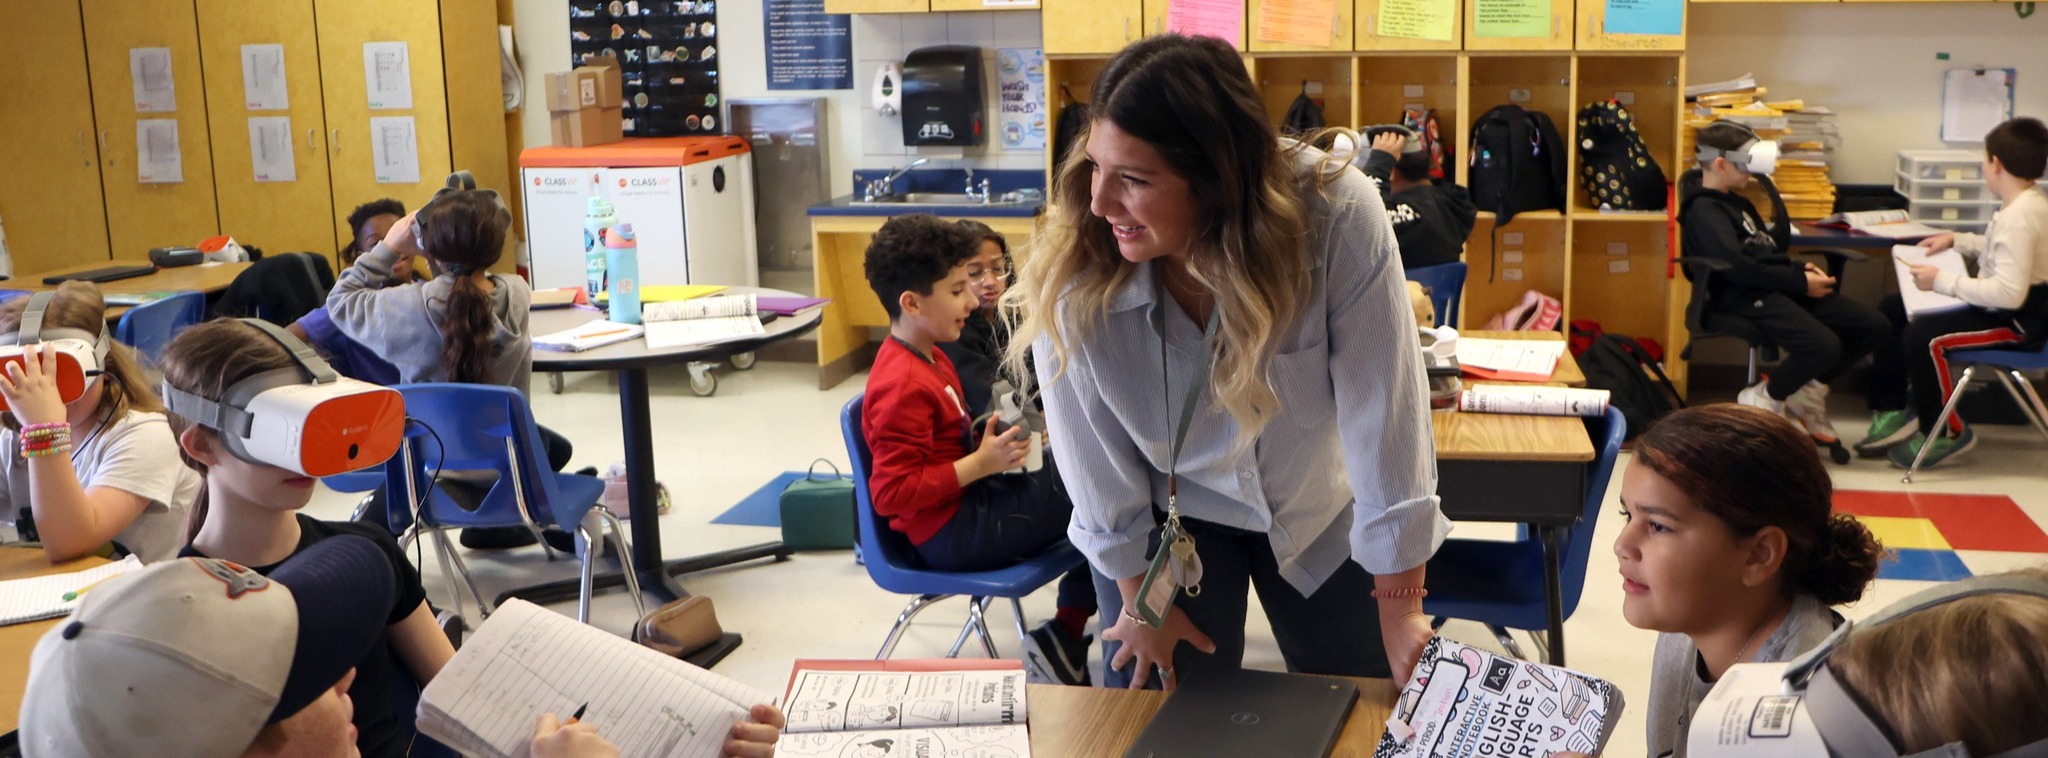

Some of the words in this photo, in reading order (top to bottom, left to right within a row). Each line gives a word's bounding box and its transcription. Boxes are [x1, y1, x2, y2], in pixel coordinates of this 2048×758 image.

[1489, 667, 1508, 686] Aa
[1446, 693, 1481, 758] INTERACTIVE
[1479, 693, 1512, 758] GLISH-
[1497, 694, 1534, 758] GUAGE
[1518, 722, 1543, 758] RTS
